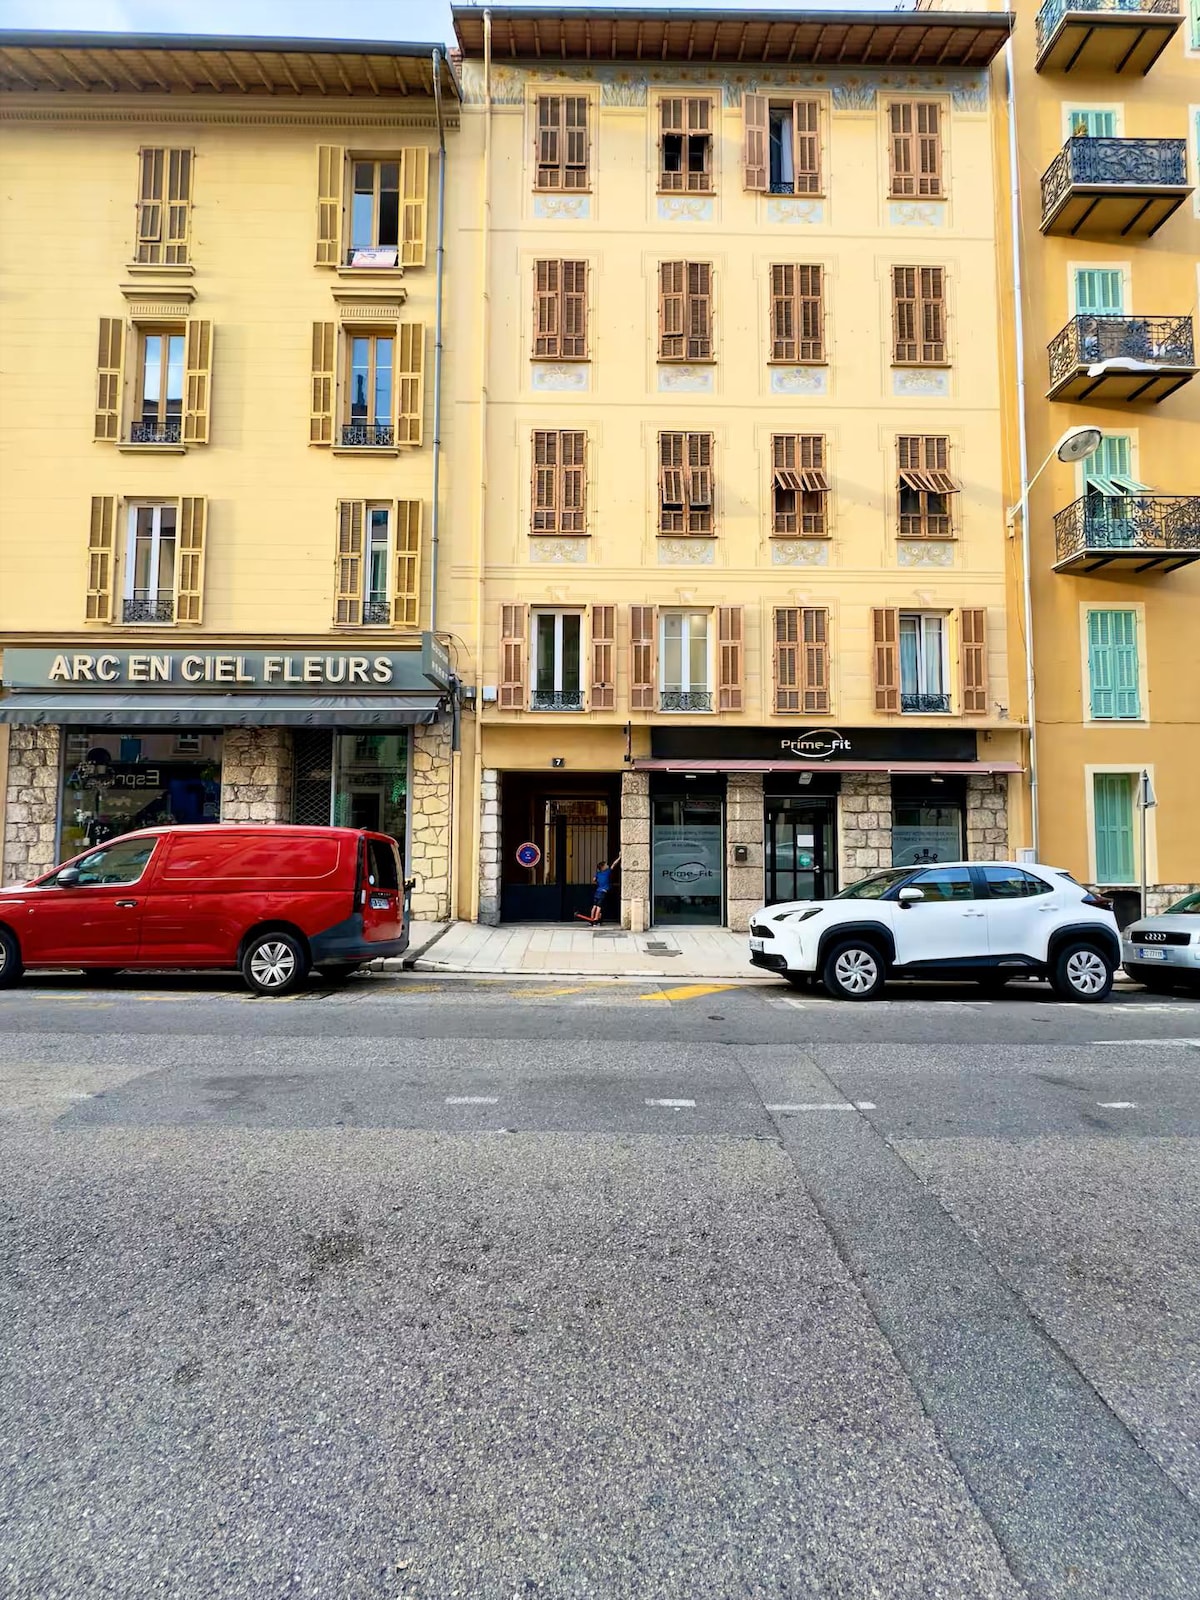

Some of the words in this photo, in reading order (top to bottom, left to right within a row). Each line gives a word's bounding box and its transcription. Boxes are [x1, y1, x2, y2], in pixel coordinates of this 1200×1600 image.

[49, 654, 120, 681] ARC
[129, 655, 173, 681] EN
[181, 655, 254, 682] CIEL
[263, 656, 394, 683] FLEURS
[780, 739, 852, 750] Prime-Fit
[555, 758, 561, 766] 7
